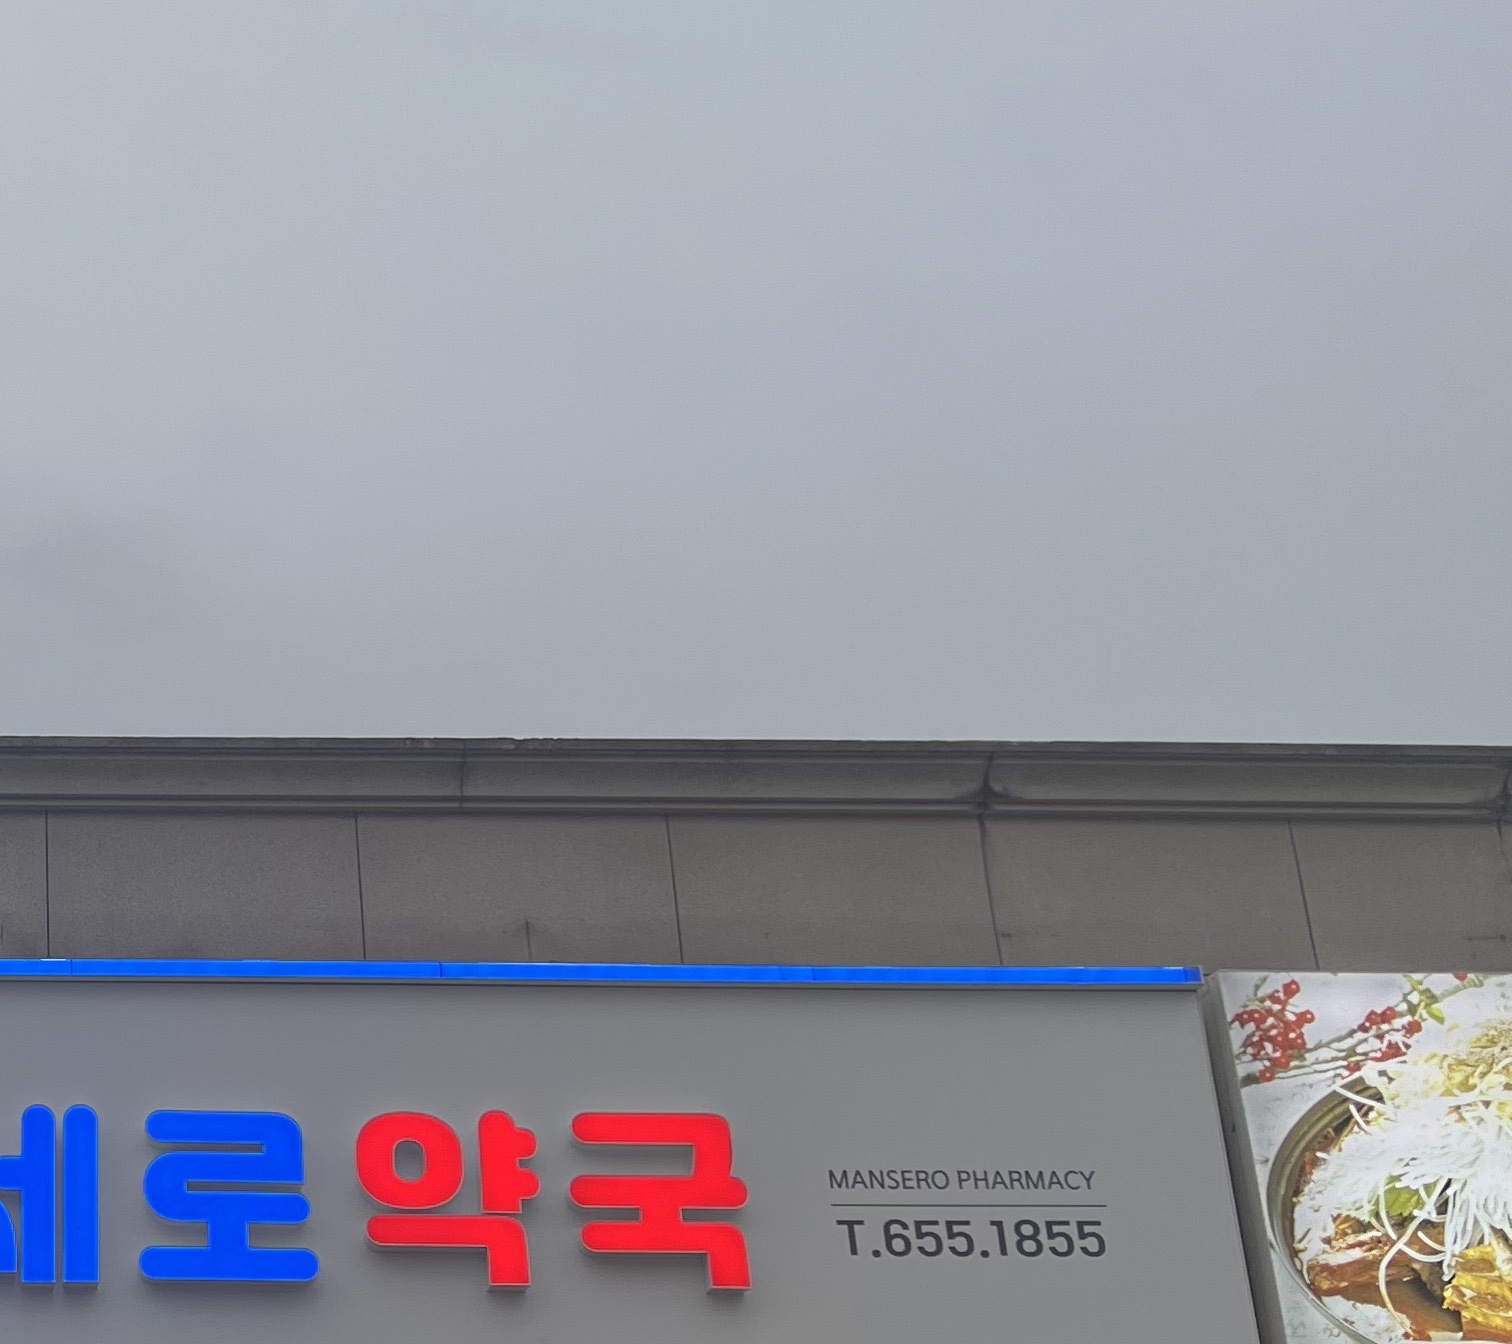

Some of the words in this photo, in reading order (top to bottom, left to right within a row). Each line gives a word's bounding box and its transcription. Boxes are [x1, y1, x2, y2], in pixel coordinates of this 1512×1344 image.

[828, 1169, 950, 1190] MANSERO
[956, 1169, 1096, 1191] PHARMACY
[835, 1218, 1106, 1259] T.655.1855
